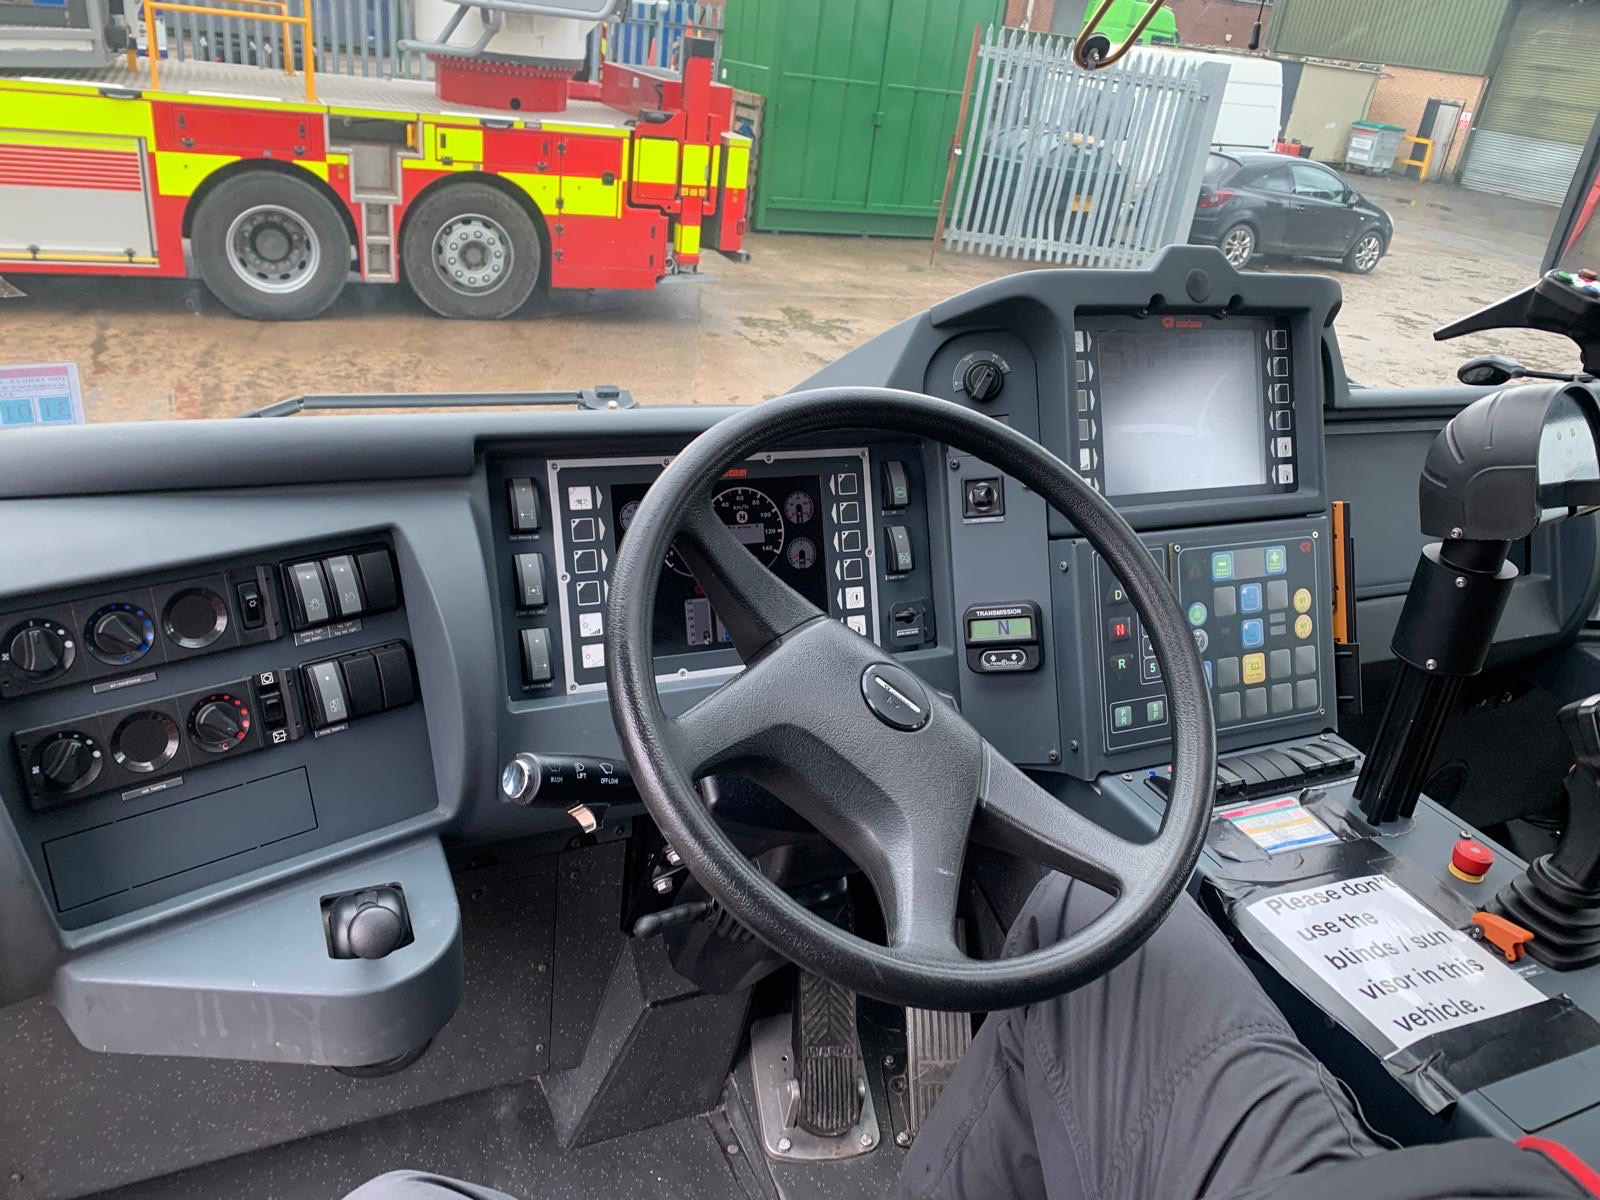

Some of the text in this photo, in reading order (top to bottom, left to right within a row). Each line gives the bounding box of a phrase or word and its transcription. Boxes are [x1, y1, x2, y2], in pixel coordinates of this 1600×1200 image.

[739, 512, 746, 522] N
[1114, 589, 1123, 600] D
[976, 608, 1022, 617] TRANSMISSION
[998, 620, 1010, 636] N
[1115, 623, 1125, 636] N
[1118, 658, 1127, 670] R
[1149, 662, 1156, 673] 5
[576, 772, 587, 780] LIFT
[1265, 887, 1341, 915] Please
[1296, 910, 1379, 942] use the
[1324, 928, 1454, 970] blinds / sun
[1359, 956, 1485, 1000] visor in this
[1393, 998, 1486, 1032] vehicle.
